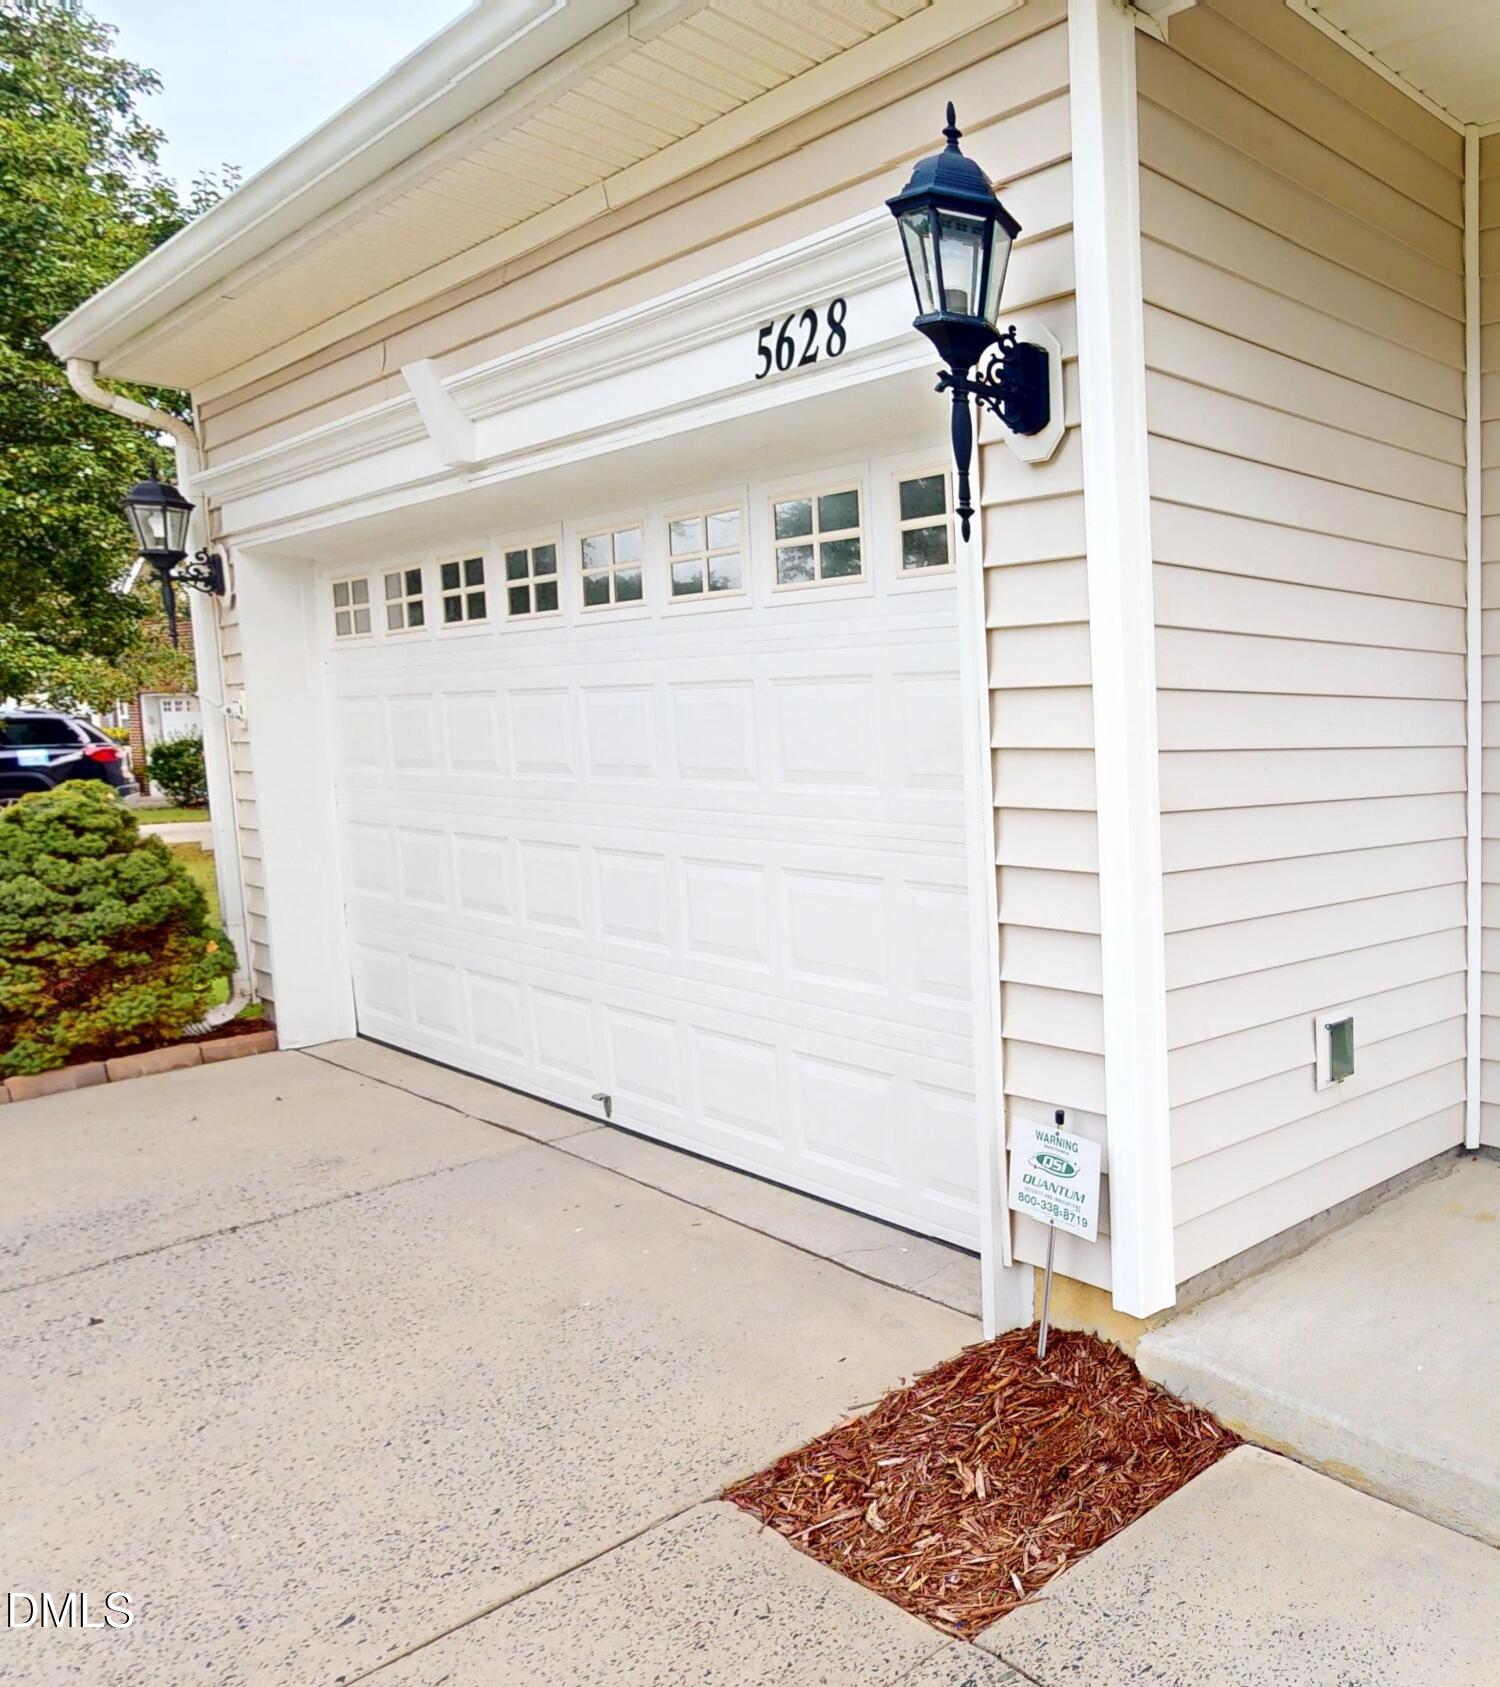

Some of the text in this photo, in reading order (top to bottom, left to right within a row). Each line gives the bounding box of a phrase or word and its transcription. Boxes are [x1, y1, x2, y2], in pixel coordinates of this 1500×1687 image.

[755, 298, 847, 380] 5628
[1035, 1129, 1079, 1153] WARNING
[1022, 1173, 1086, 1204] QUANTUM
[1018, 1191, 1088, 1228] 800-338-8719
